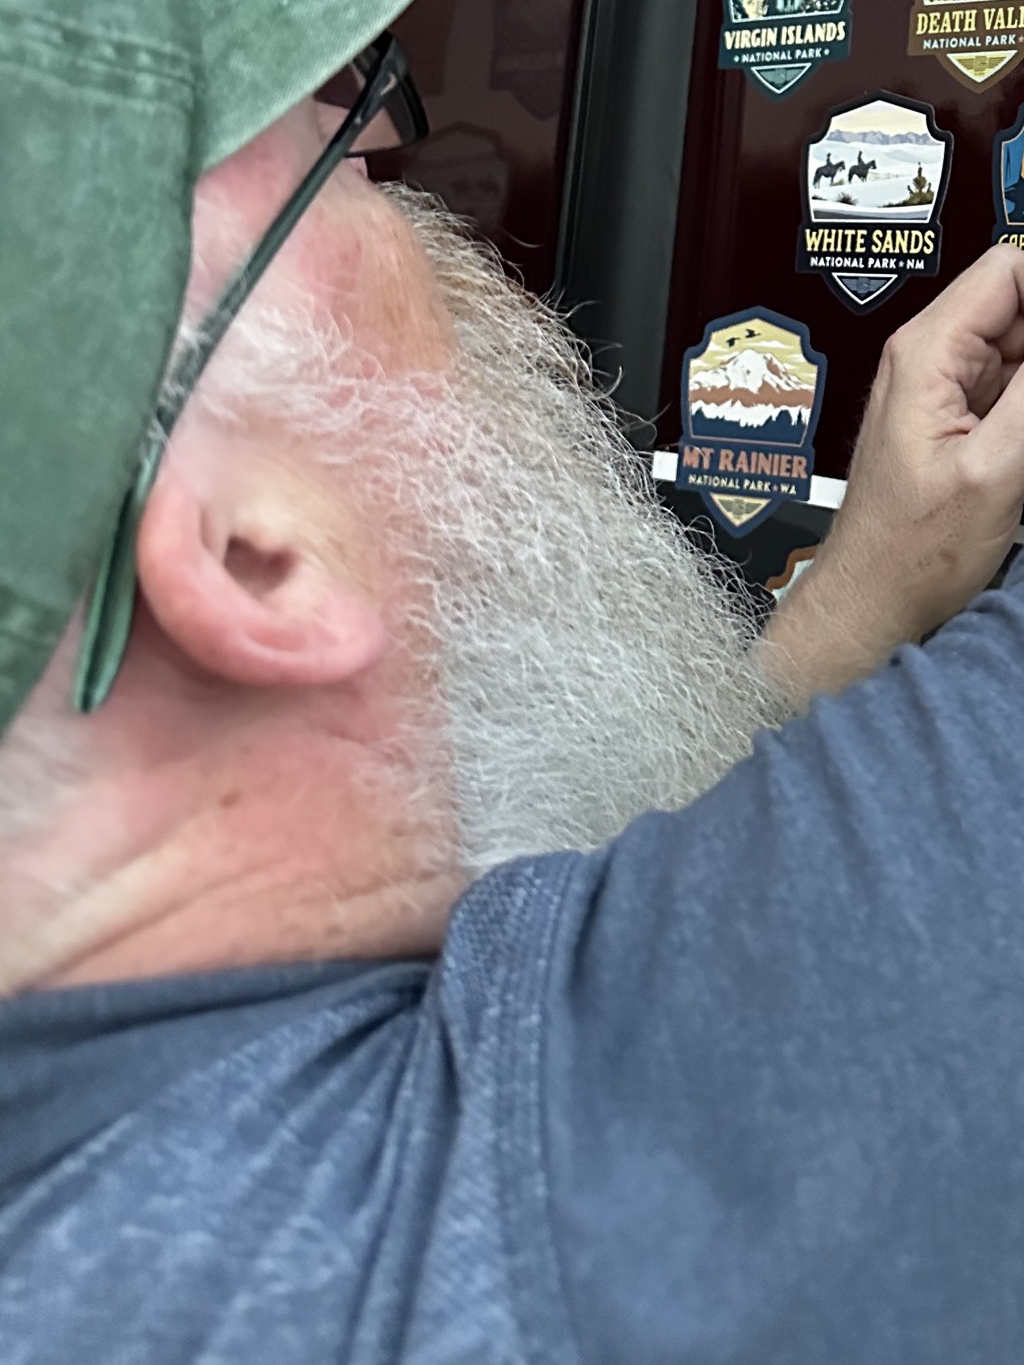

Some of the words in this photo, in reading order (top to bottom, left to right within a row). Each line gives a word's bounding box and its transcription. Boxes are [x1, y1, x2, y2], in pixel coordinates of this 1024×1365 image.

[917, 9, 977, 35] DEATH
[724, 28, 777, 49] VIRGIN
[781, 21, 845, 46] ISLANDS
[924, 35, 982, 49] NATIONAL
[985, 34, 1016, 46] PARK
[742, 50, 792, 62] NATIONAL
[796, 47, 821, 59] PARK
[805, 229, 867, 254] WHITE
[871, 230, 935, 256] SANDS
[810, 257, 865, 269] NATIONAL
[867, 257, 896, 269] PARK
[906, 258, 924, 269] NM
[683, 447, 714, 470] MT
[719, 450, 807, 479] RAINIER
[689, 474, 740, 492] NATIONAL
[743, 478, 771, 493] PARK
[781, 483, 797, 495] WA
